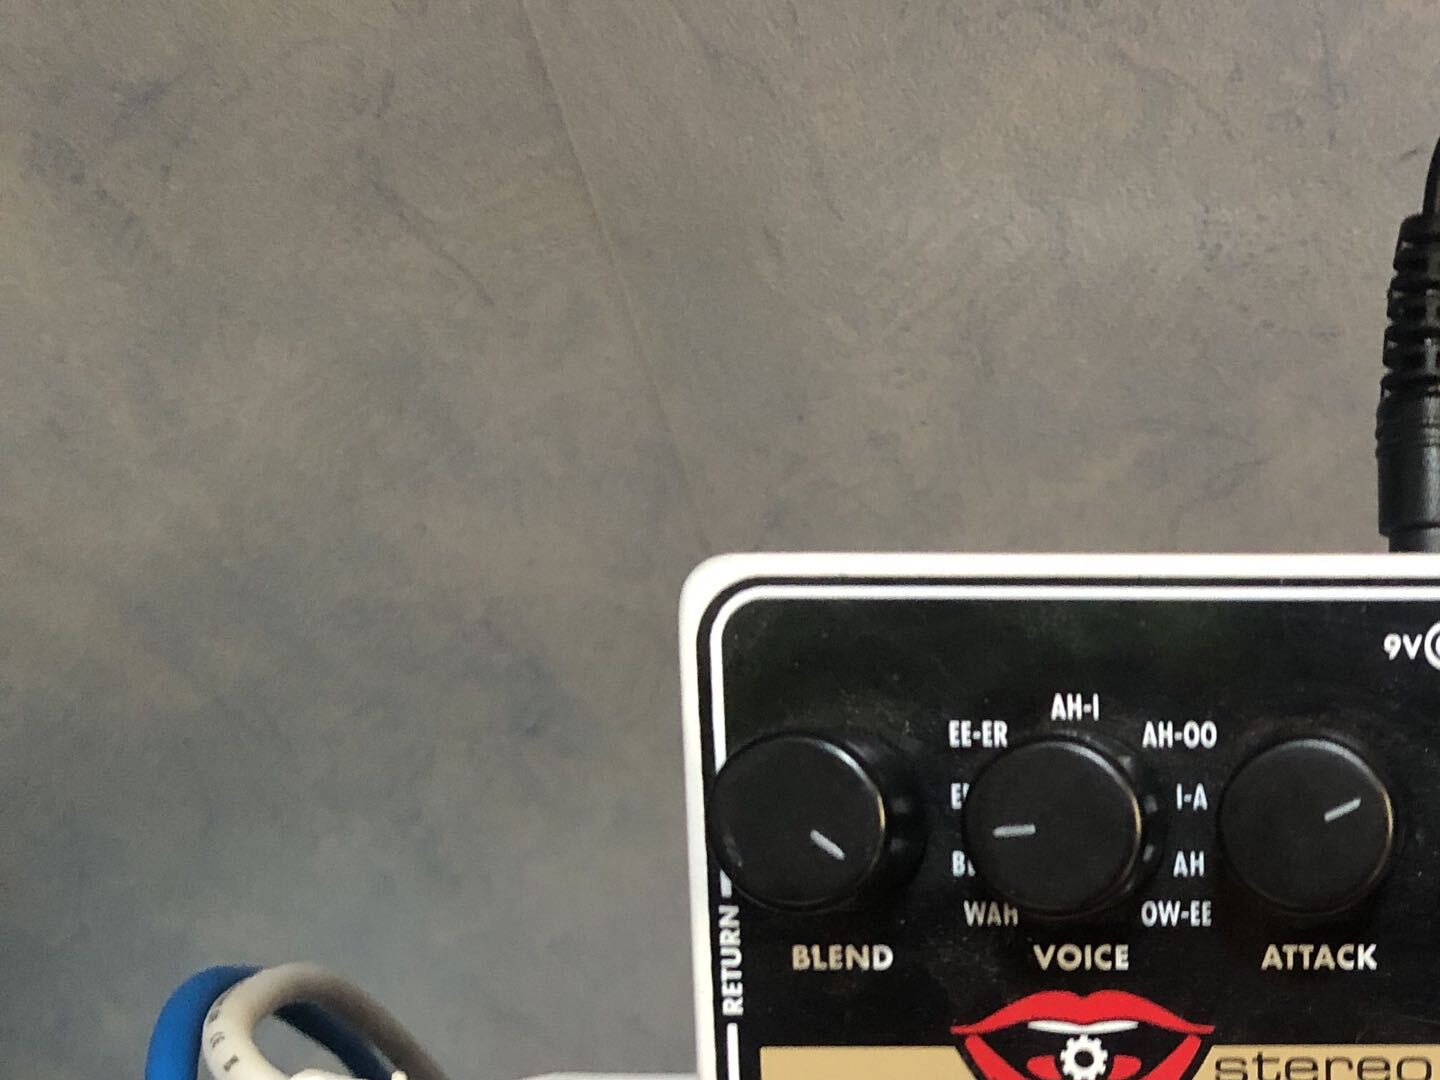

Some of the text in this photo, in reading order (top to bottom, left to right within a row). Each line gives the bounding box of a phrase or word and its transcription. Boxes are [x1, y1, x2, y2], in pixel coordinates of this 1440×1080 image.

[1383, 633, 1423, 660] 9V
[1051, 692, 1100, 721] AH-I
[948, 719, 1008, 748] EE-ER
[1142, 720, 1218, 749] AH-OO
[1176, 783, 1208, 810] I-A
[1173, 851, 1205, 877] AH
[1141, 900, 1212, 927] OW-EE
[718, 905, 743, 1017] RETURN
[792, 944, 894, 971] BLEND
[1033, 943, 1130, 971] VOICE
[1261, 943, 1378, 971] ATTACK
